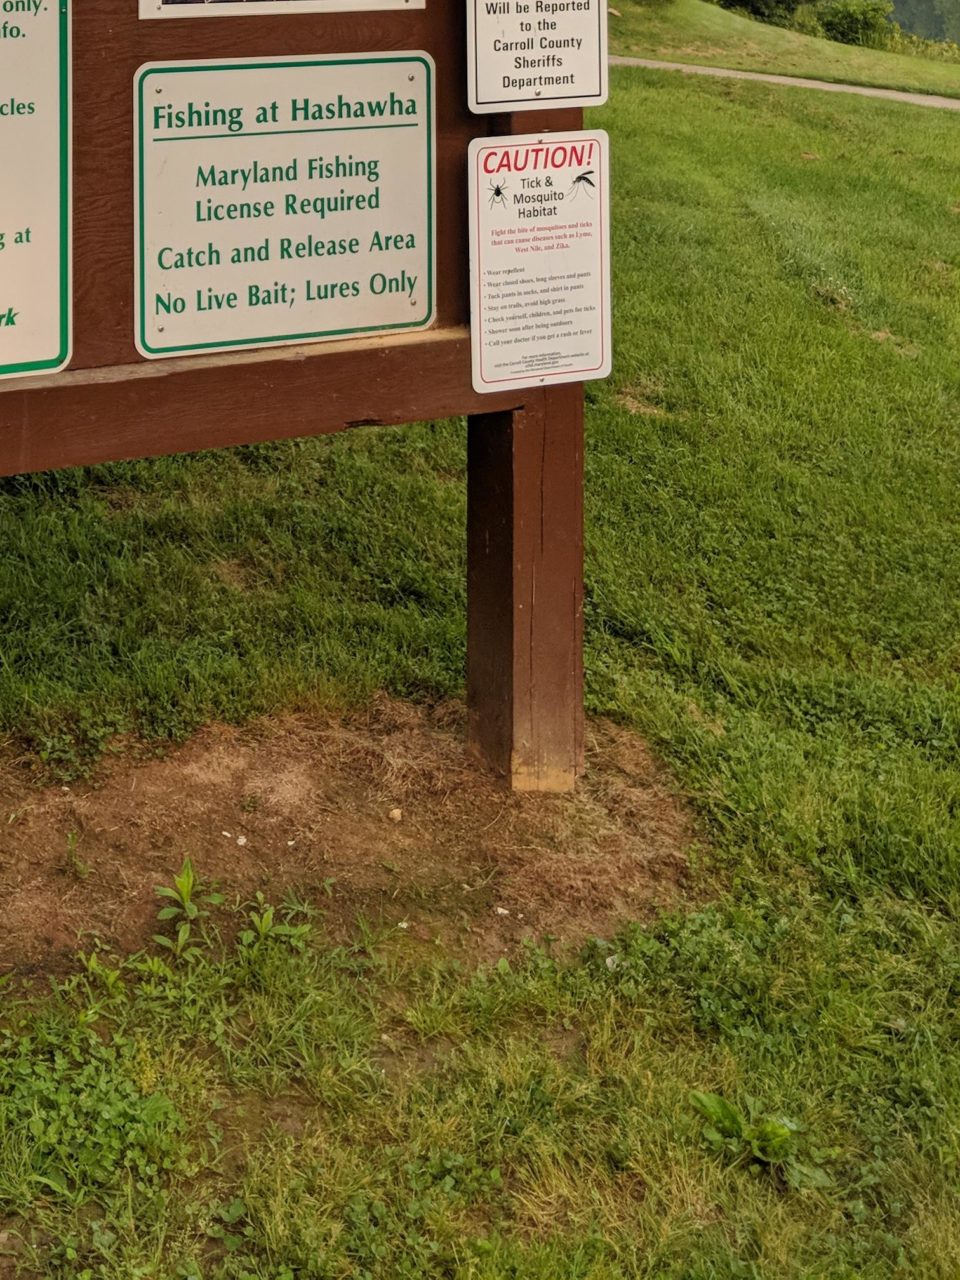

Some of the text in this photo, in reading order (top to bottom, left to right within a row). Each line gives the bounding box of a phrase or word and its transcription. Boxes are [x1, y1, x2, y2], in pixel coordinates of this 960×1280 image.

[485, 2, 510, 15] Will
[516, 1, 529, 14] be
[520, 18, 556, 32] to the
[493, 37, 582, 52] Carroll County
[514, 54, 563, 69] Sheriffs
[502, 74, 574, 90] Department
[153, 92, 417, 132] Fishing at Hashawha
[483, 143, 593, 174] CAUTION!
[196, 155, 379, 191] Maryland Fishing
[520, 176, 553, 189] Tick &
[196, 186, 379, 222] License Required
[513, 190, 564, 205] Mosquito
[518, 206, 557, 219] Habitat
[14, 228, 31, 244] at
[158, 231, 416, 270] Catch and Release Area
[155, 270, 417, 315] No Live Bait; Lures Only
